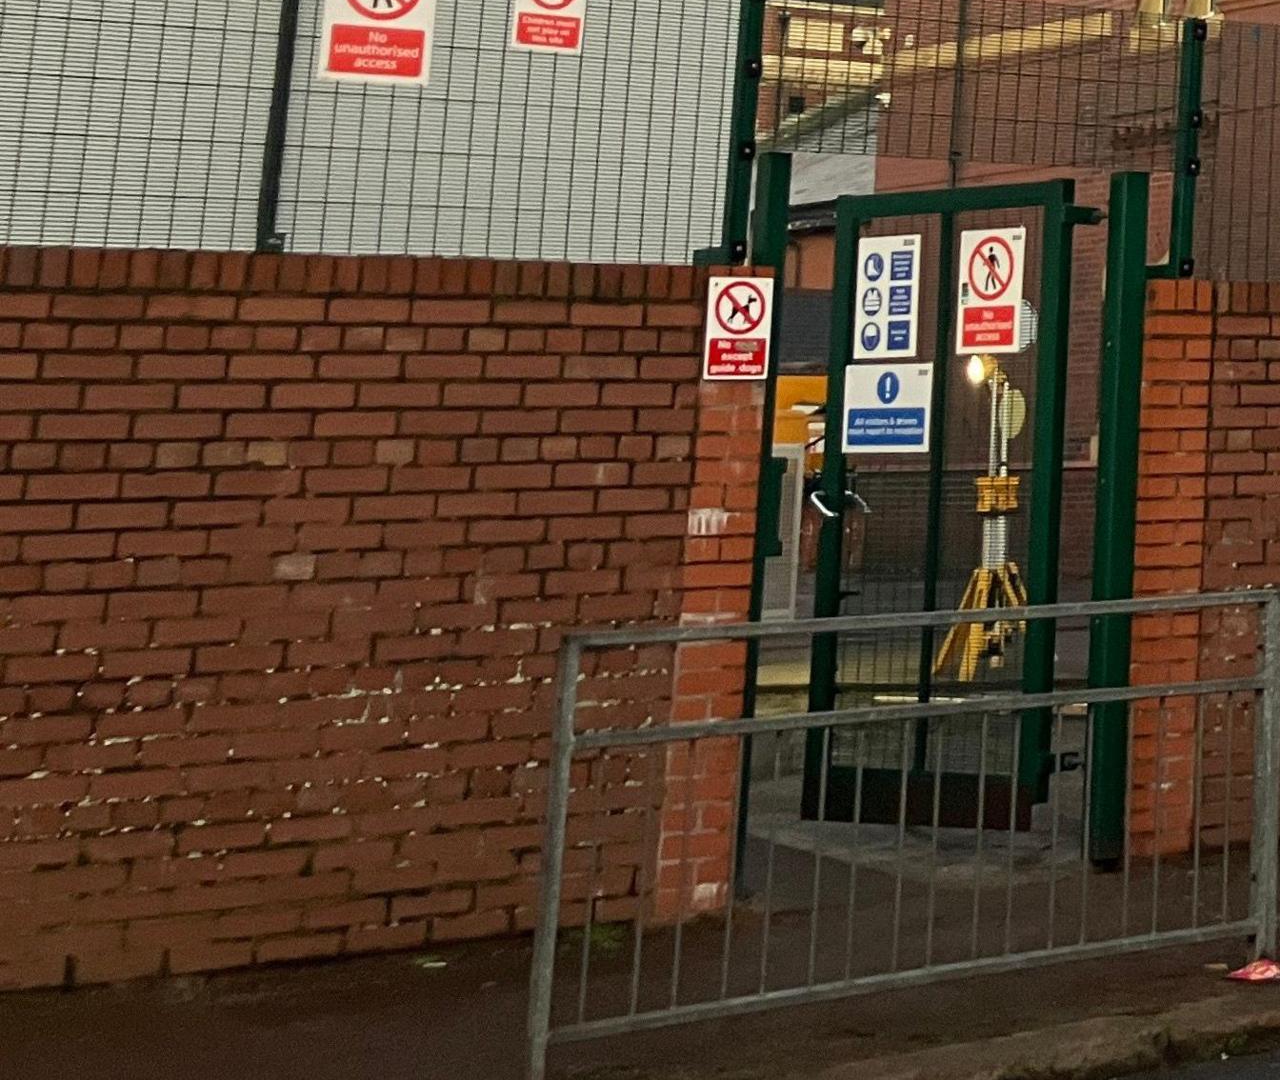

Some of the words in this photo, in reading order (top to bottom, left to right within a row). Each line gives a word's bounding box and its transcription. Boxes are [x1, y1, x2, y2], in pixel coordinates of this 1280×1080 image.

[368, 31, 388, 44] No
[334, 43, 420, 58] unauthorised
[353, 57, 398, 70] access
[717, 340, 732, 349] No
[720, 352, 753, 361] except
[709, 363, 736, 374] guide
[739, 363, 763, 374] dogs
